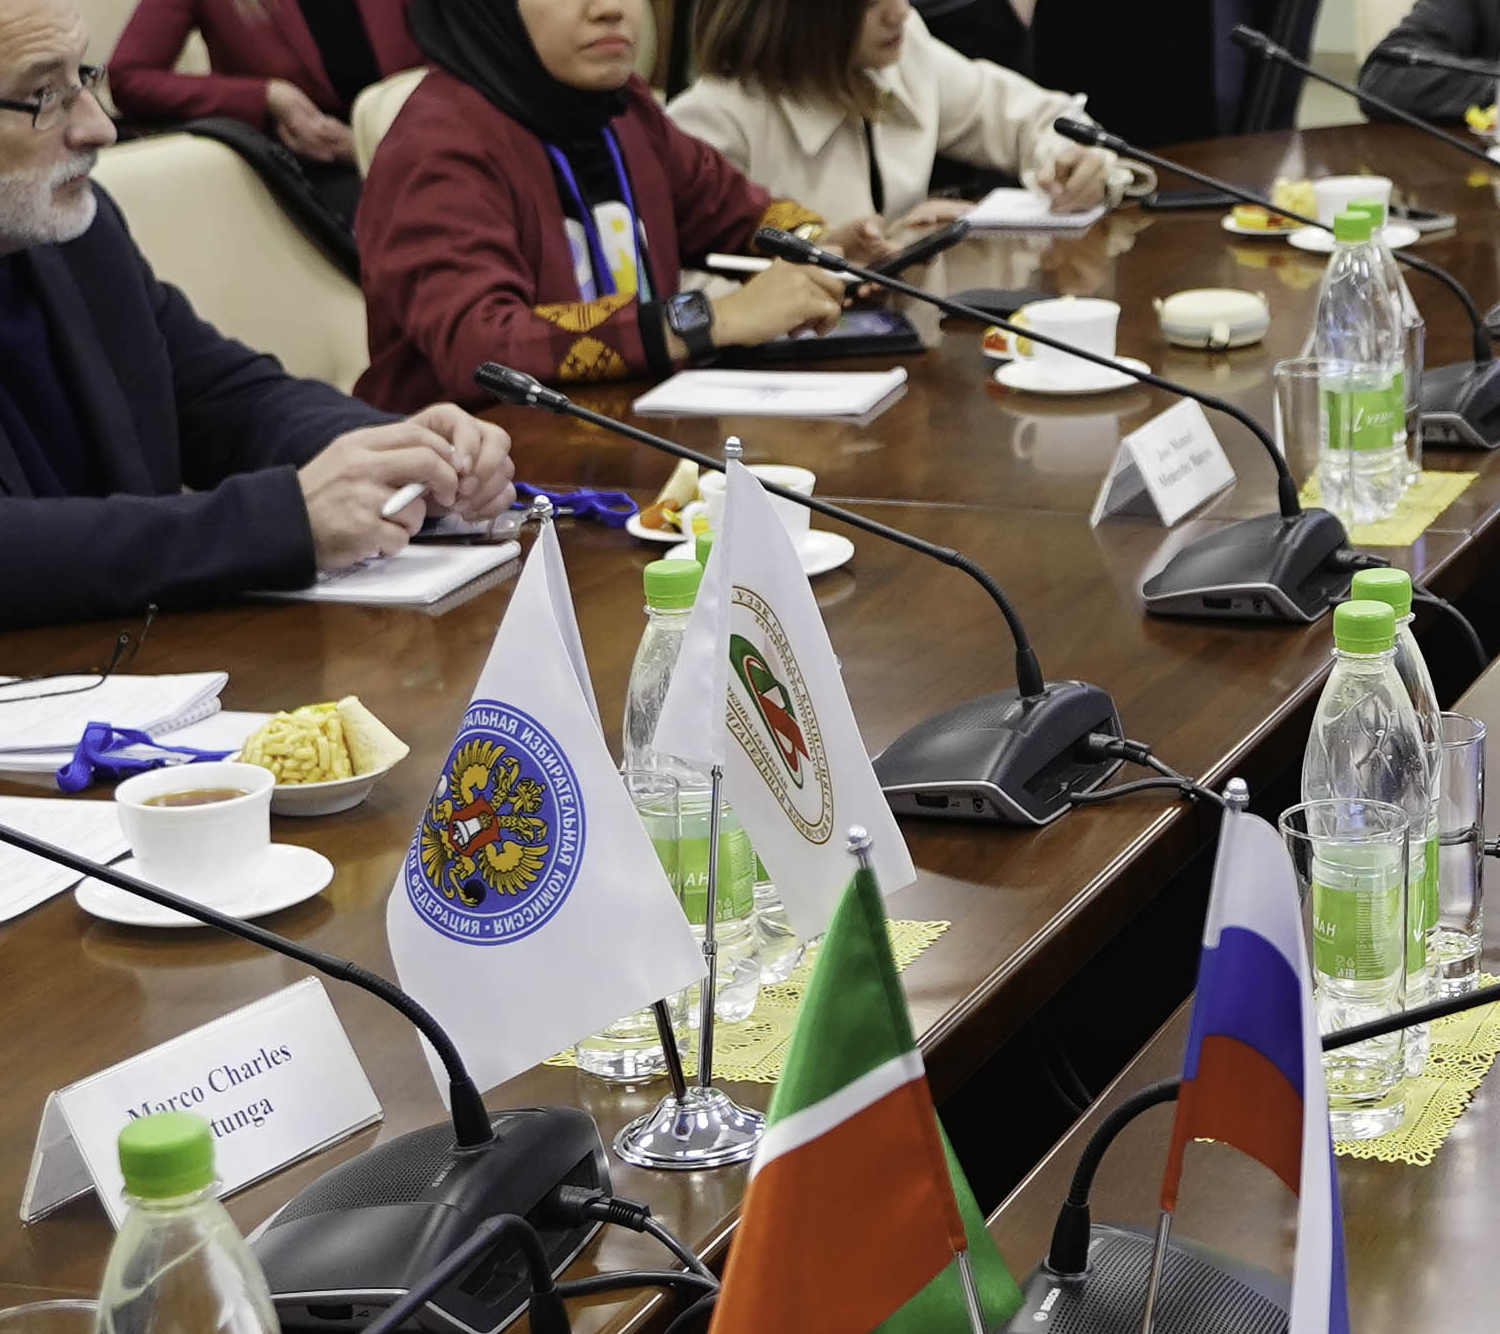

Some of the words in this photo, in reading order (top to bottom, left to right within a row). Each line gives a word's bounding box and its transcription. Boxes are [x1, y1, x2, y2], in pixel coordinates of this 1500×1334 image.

[520, 726, 577, 866] ИЗБИРАТЕЛЬНАЯ
[410, 874, 481, 935] ФЕДЕРАЦИЯ
[493, 872, 567, 935] КОМИССИЯ
[207, 1041, 293, 1094] Charles
